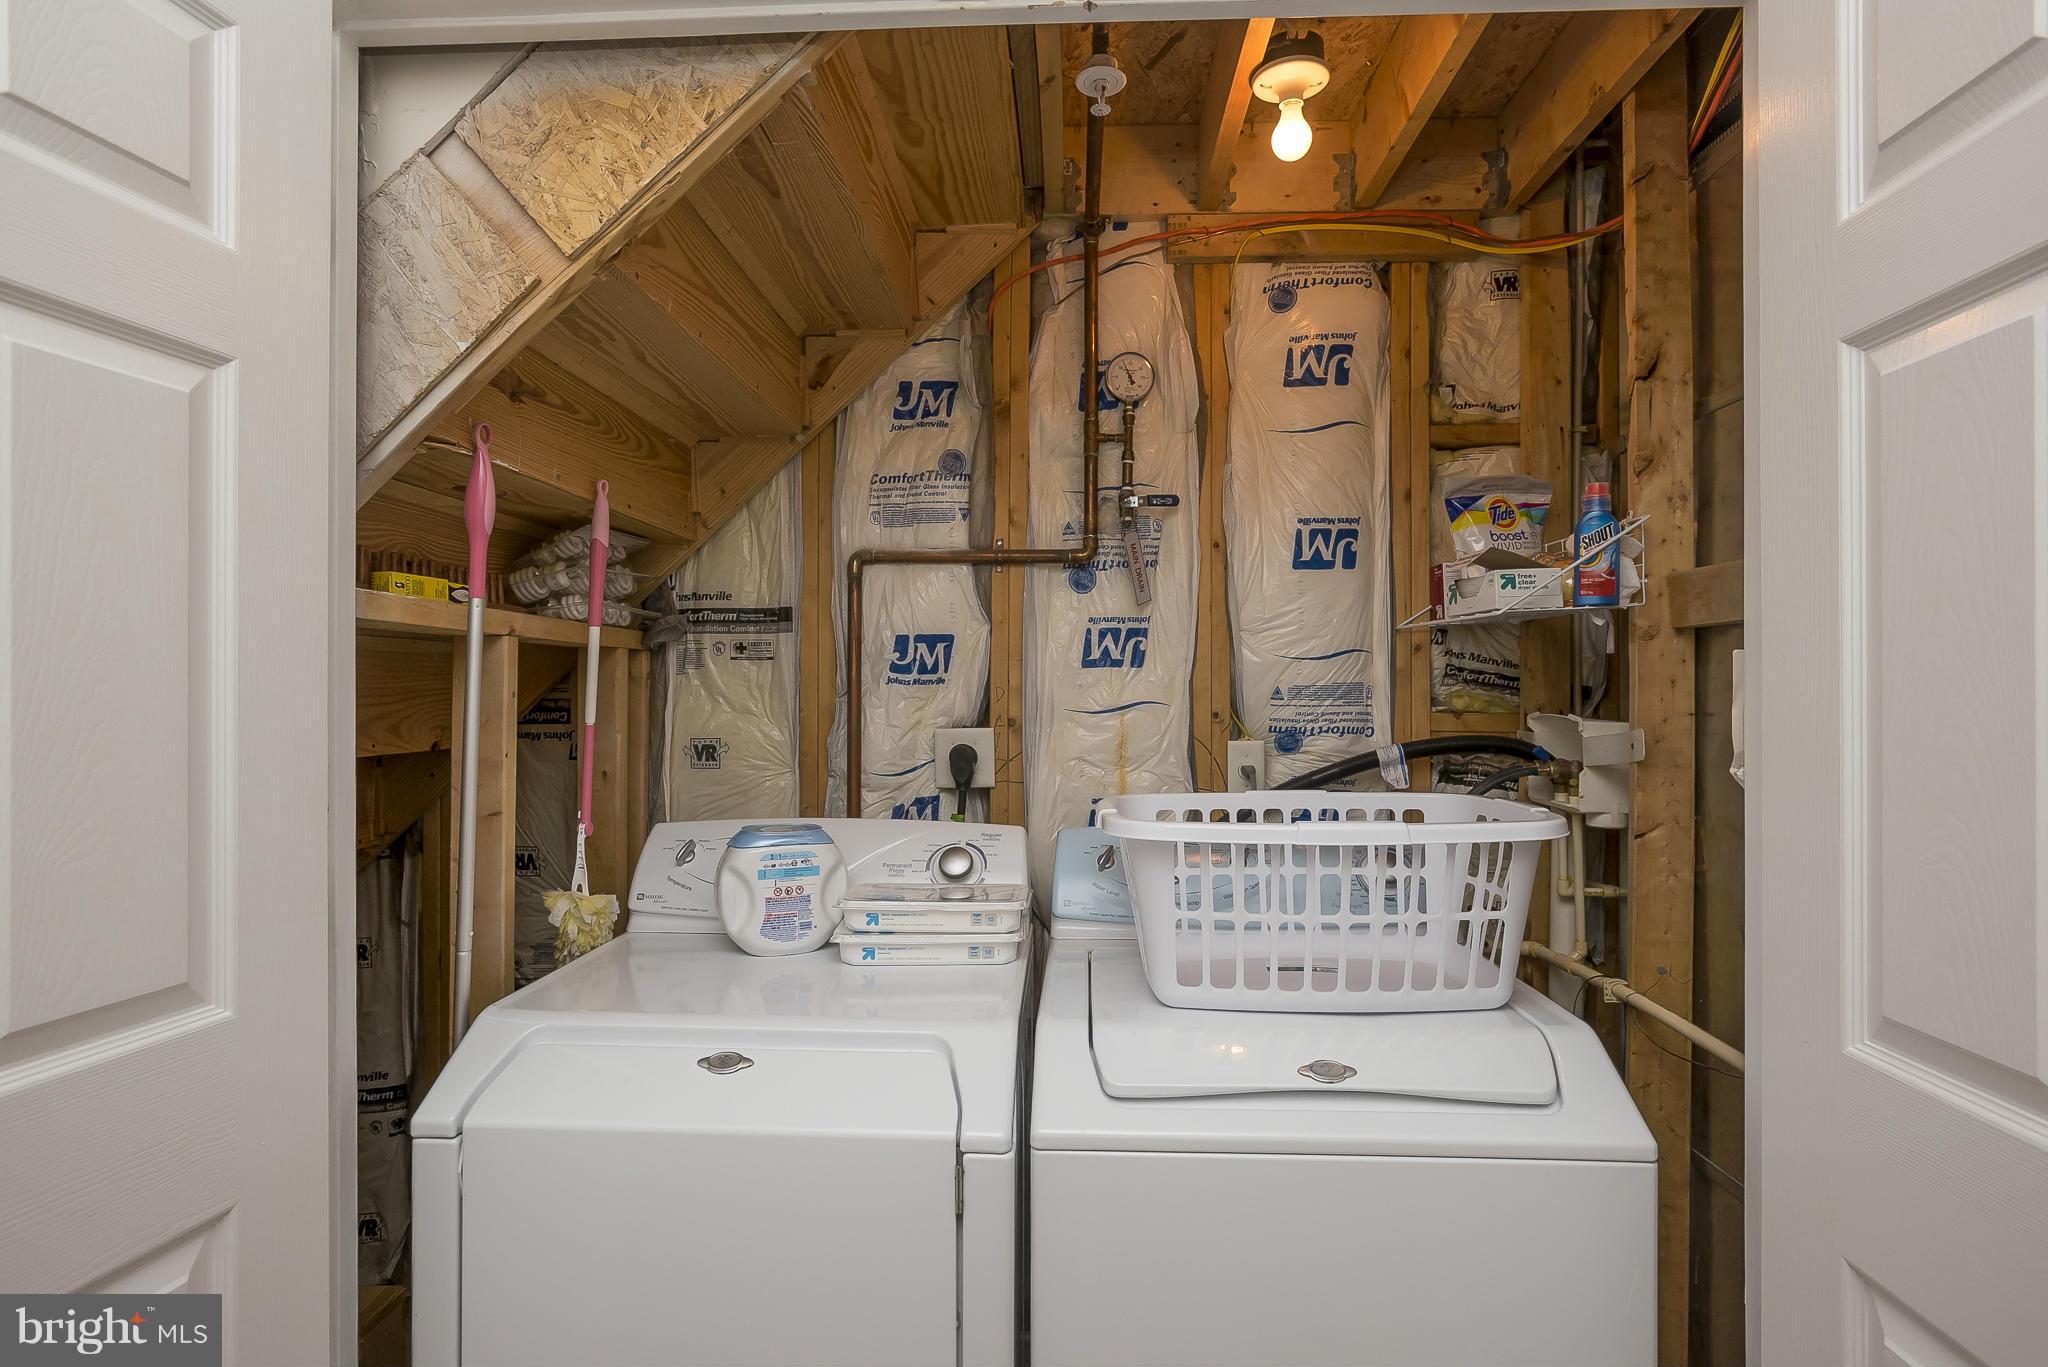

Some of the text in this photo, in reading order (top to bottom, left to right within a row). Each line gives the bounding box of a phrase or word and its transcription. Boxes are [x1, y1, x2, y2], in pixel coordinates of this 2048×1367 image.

[1262, 277, 1373, 294] ComfortTherm
[1288, 331, 1358, 344] Johns Maville
[1282, 343, 1354, 388] JM
[892, 380, 959, 420] JM
[869, 470, 971, 485] ComfortTherm
[1297, 517, 1361, 526] Johns Manville
[1488, 504, 1517, 526] Tide
[1489, 530, 1529, 542] boost
[1581, 523, 1615, 551] SHOUT
[1291, 528, 1359, 570] JM
[1129, 542, 1146, 594] MAIN DRAIN
[729, 624, 760, 633] Comfort
[1087, 615, 1151, 625] Johns Manville
[888, 633, 956, 676] JM
[1081, 627, 1149, 668] JM
[1467, 651, 1520, 670] Manville
[885, 676, 946, 686] Johns Manville
[1446, 666, 1520, 688] CfortTherm
[543, 730, 576, 742] Johns
[1268, 725, 1375, 737] ComfortTherm
[693, 743, 719, 762] VR
